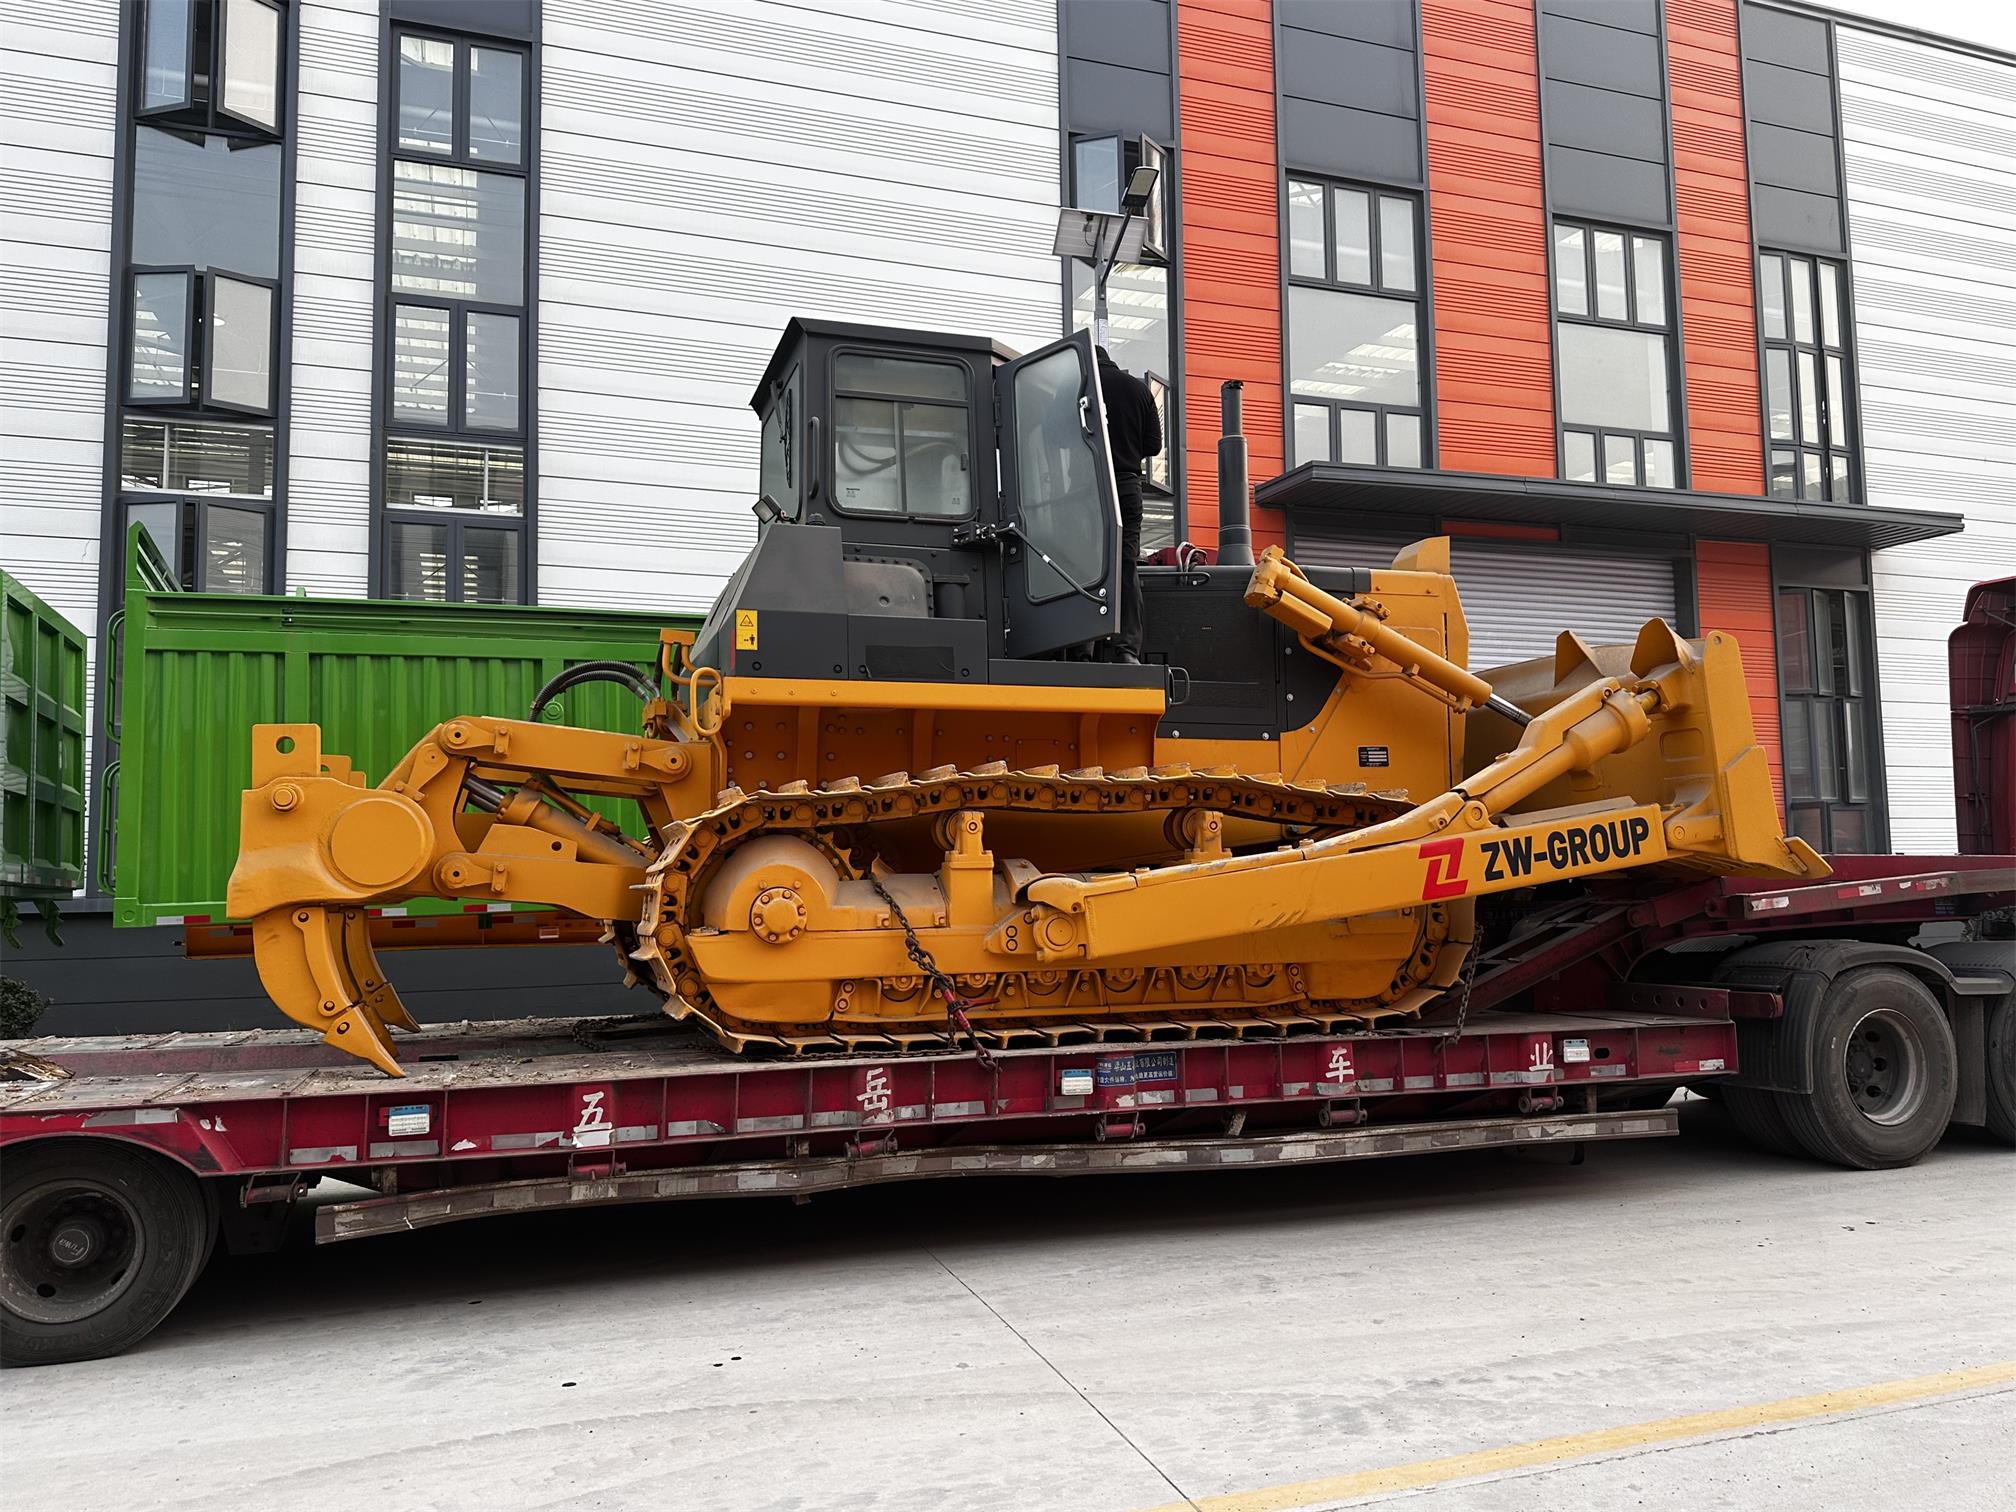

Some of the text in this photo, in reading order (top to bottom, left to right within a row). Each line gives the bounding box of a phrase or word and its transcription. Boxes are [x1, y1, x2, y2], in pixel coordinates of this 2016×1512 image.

[1480, 817, 1649, 881] ZW-GROUP
[573, 1041, 1554, 1133] 五 岳 车 业
